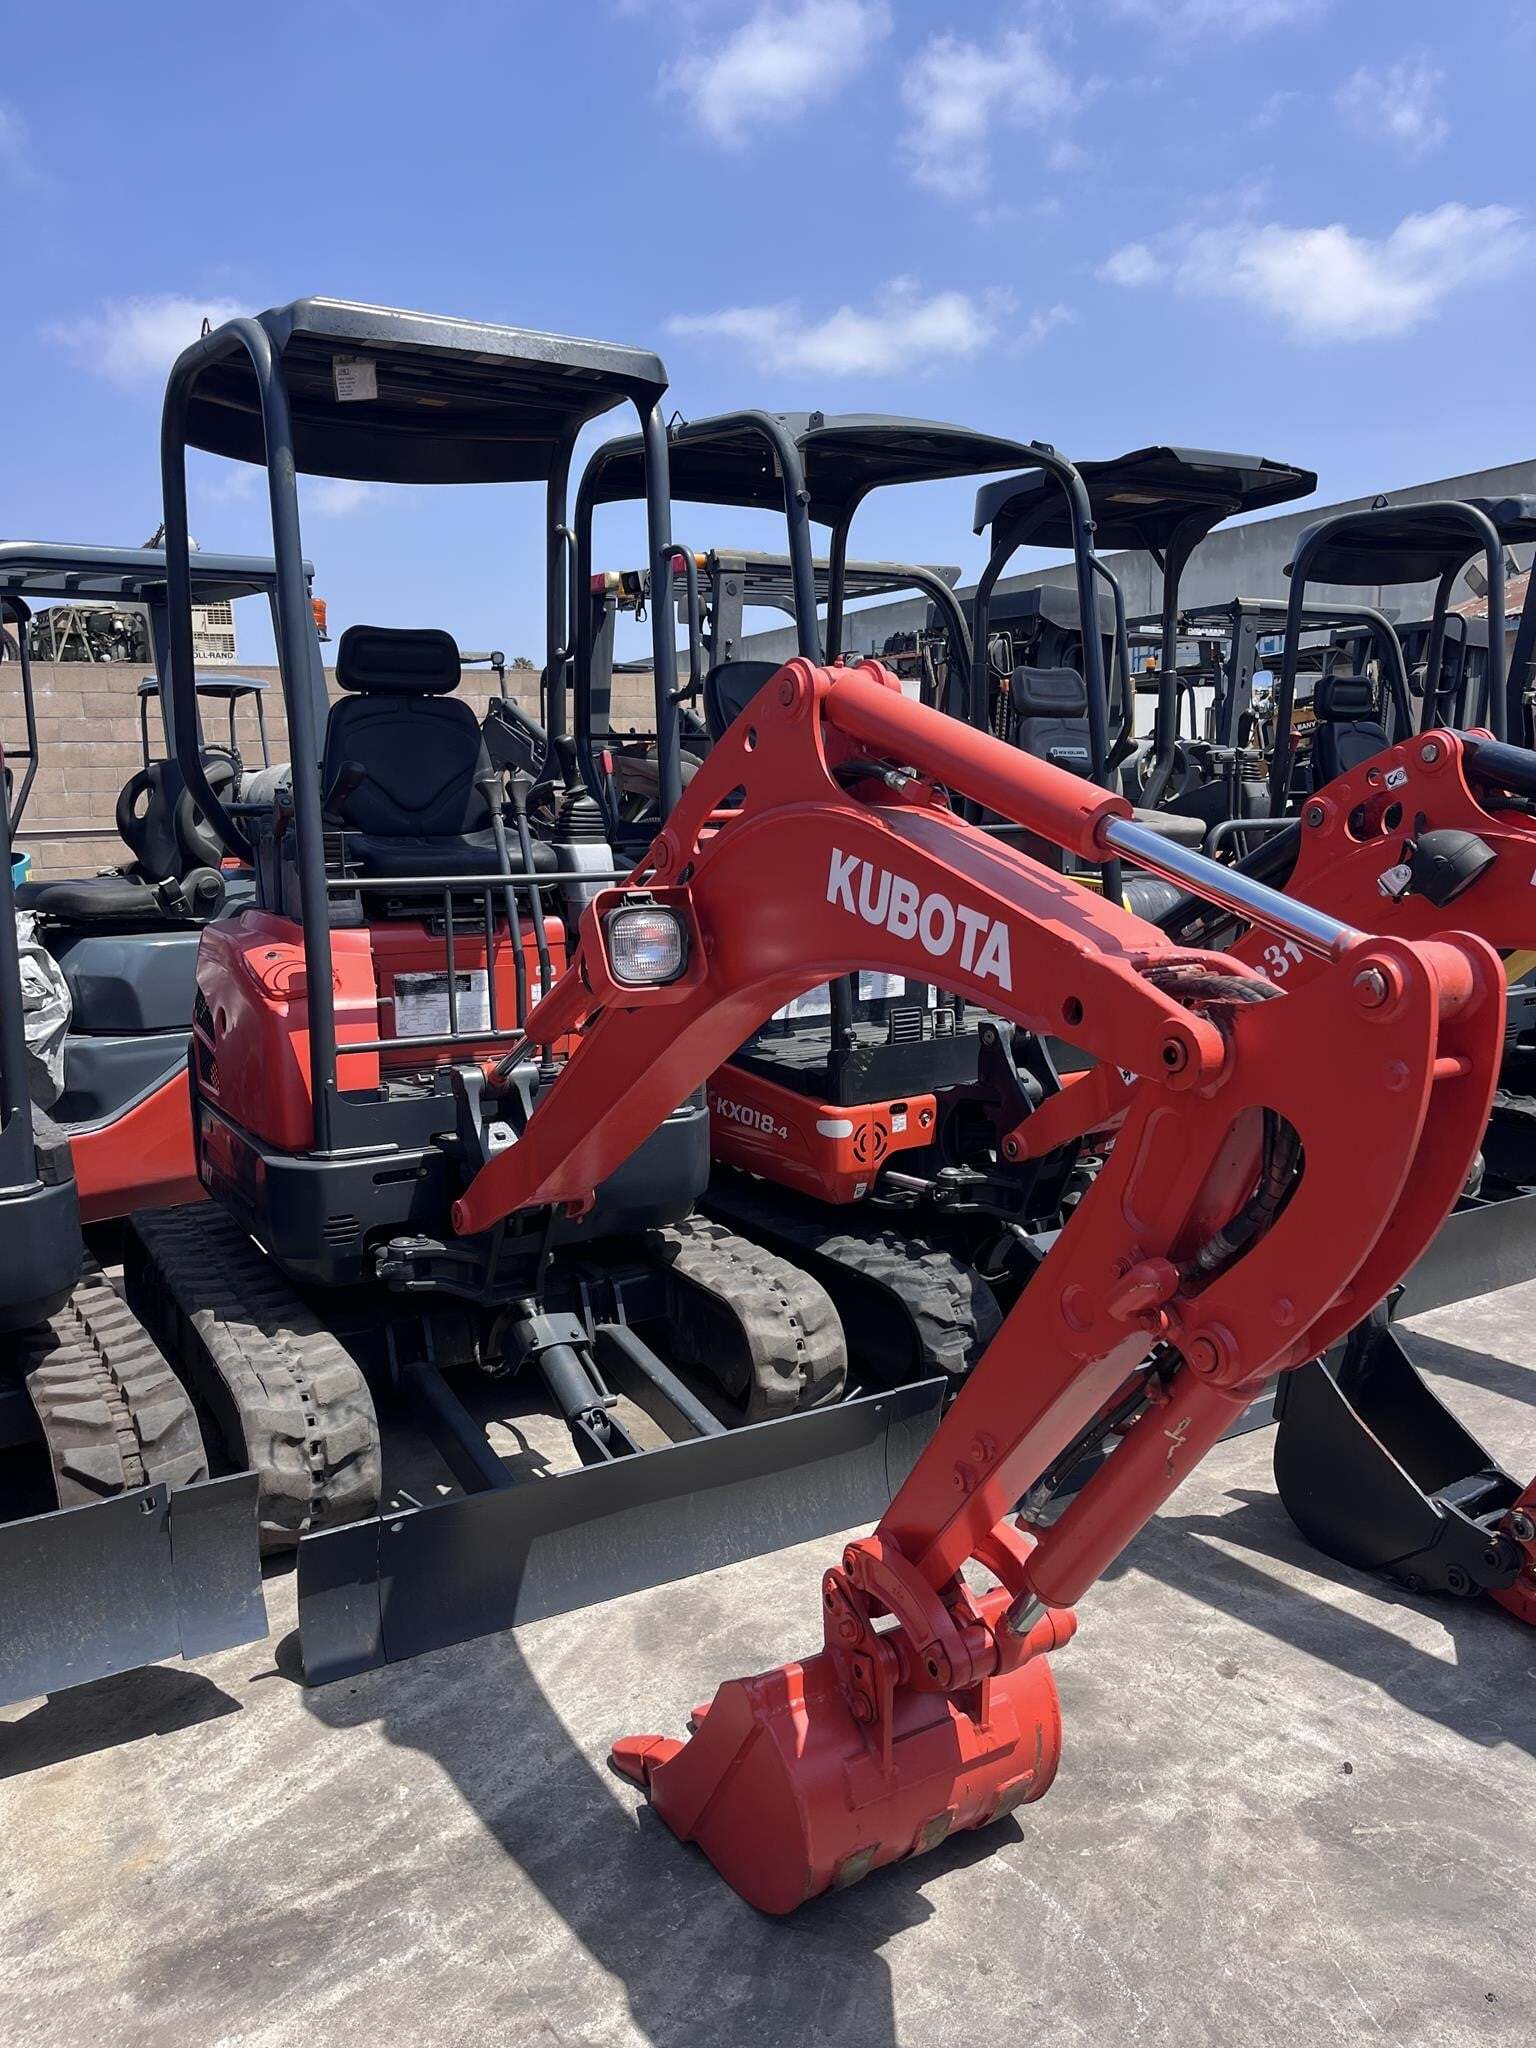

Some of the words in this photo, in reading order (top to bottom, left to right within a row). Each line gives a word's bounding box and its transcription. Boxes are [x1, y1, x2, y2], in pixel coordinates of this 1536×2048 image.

[826, 847, 1012, 992] KUBOTA
[1254, 939, 1304, 981] 31
[716, 1096, 789, 1140] KX018-4
